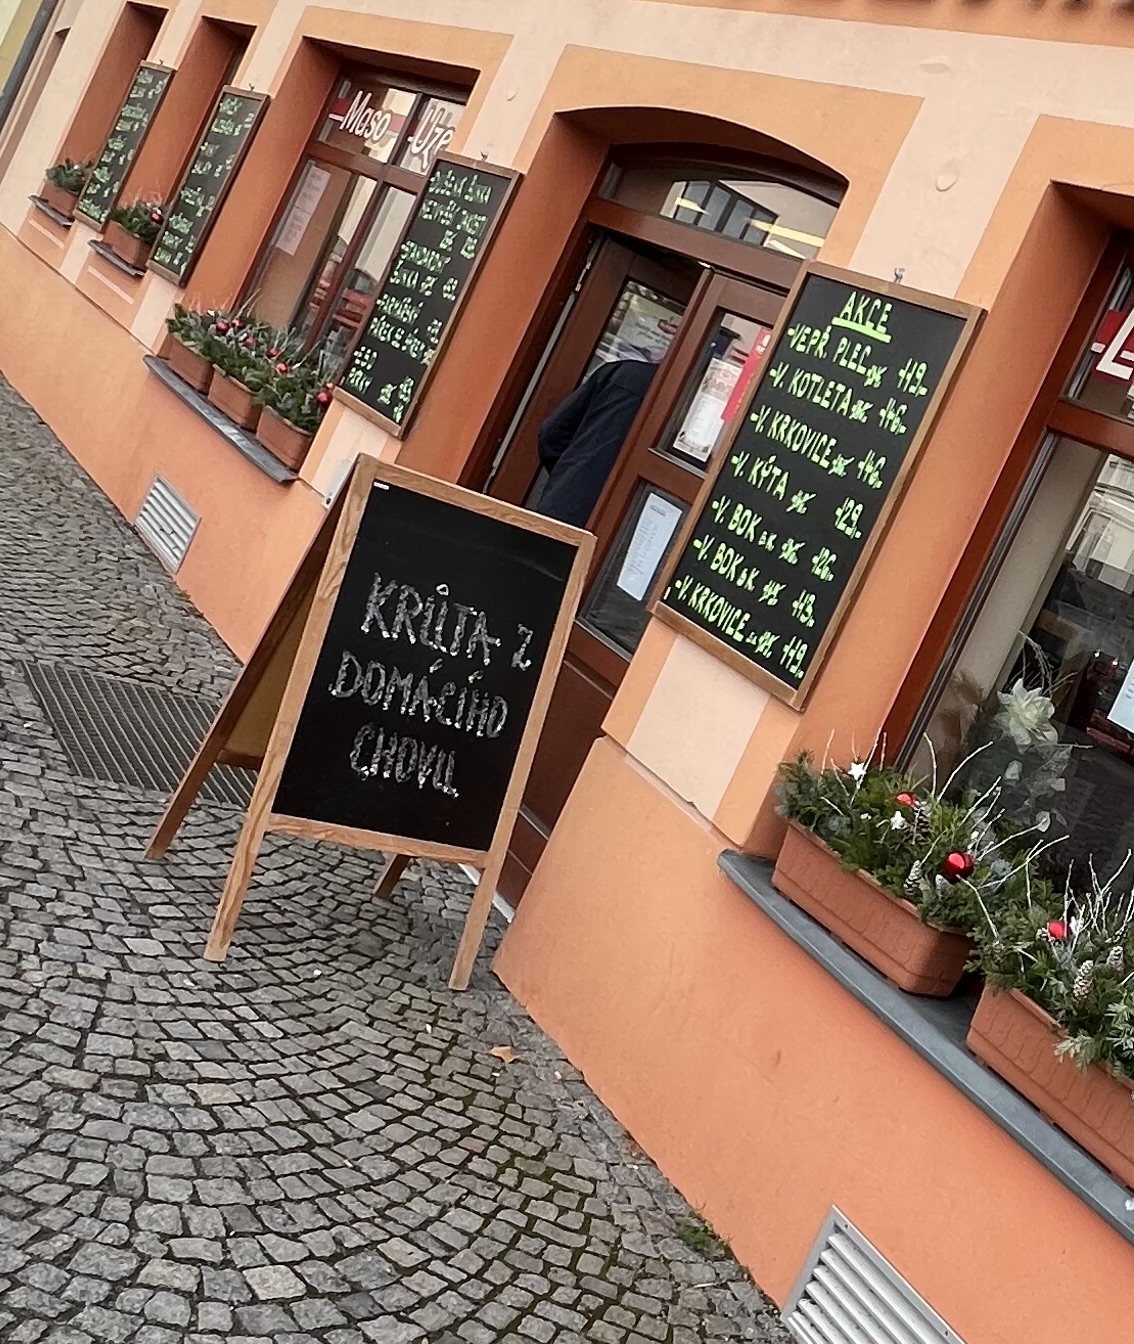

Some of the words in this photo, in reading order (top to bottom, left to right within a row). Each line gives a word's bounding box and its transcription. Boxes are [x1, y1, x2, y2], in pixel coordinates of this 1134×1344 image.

[339, 90, 392, 141] Maso
[839, 291, 892, 332] AKCE
[788, 368, 852, 416] KOTLETA
[767, 411, 836, 468] KRKOVICE
[748, 455, 788, 500] KÝTA
[728, 504, 762, 542] BOK
[710, 543, 744, 581] BOK
[360, 572, 502, 666] KRŮTA
[688, 583, 750, 642] KRKOVICE
[328, 650, 509, 739] DOMÁCÍHO
[350, 721, 460, 798] CHOVU
